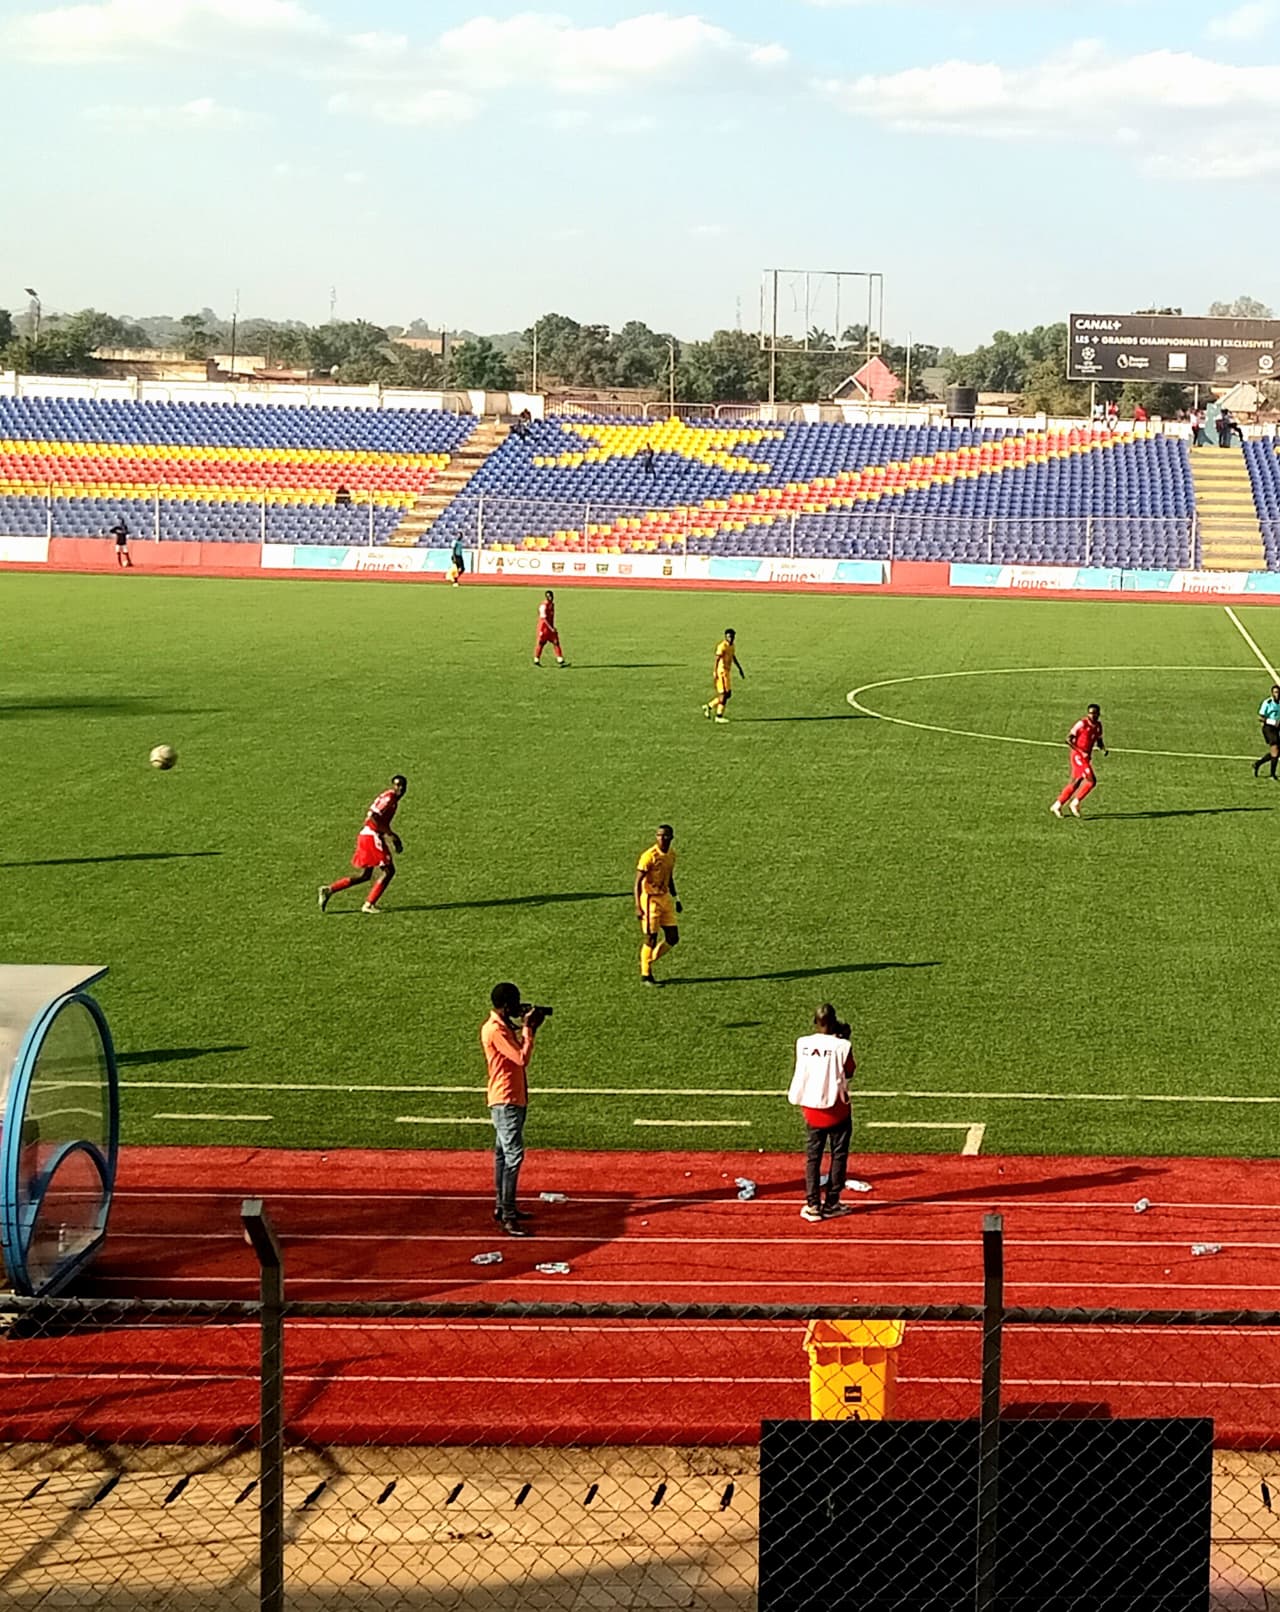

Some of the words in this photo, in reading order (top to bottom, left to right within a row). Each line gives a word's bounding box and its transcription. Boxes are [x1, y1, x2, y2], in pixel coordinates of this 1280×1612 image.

[1075, 319, 1122, 330] CANAL+
[1075, 335, 1089, 344] LES
[1101, 335, 1138, 345] GRANDS
[1139, 337, 1208, 347] CHAMPIONNATS
